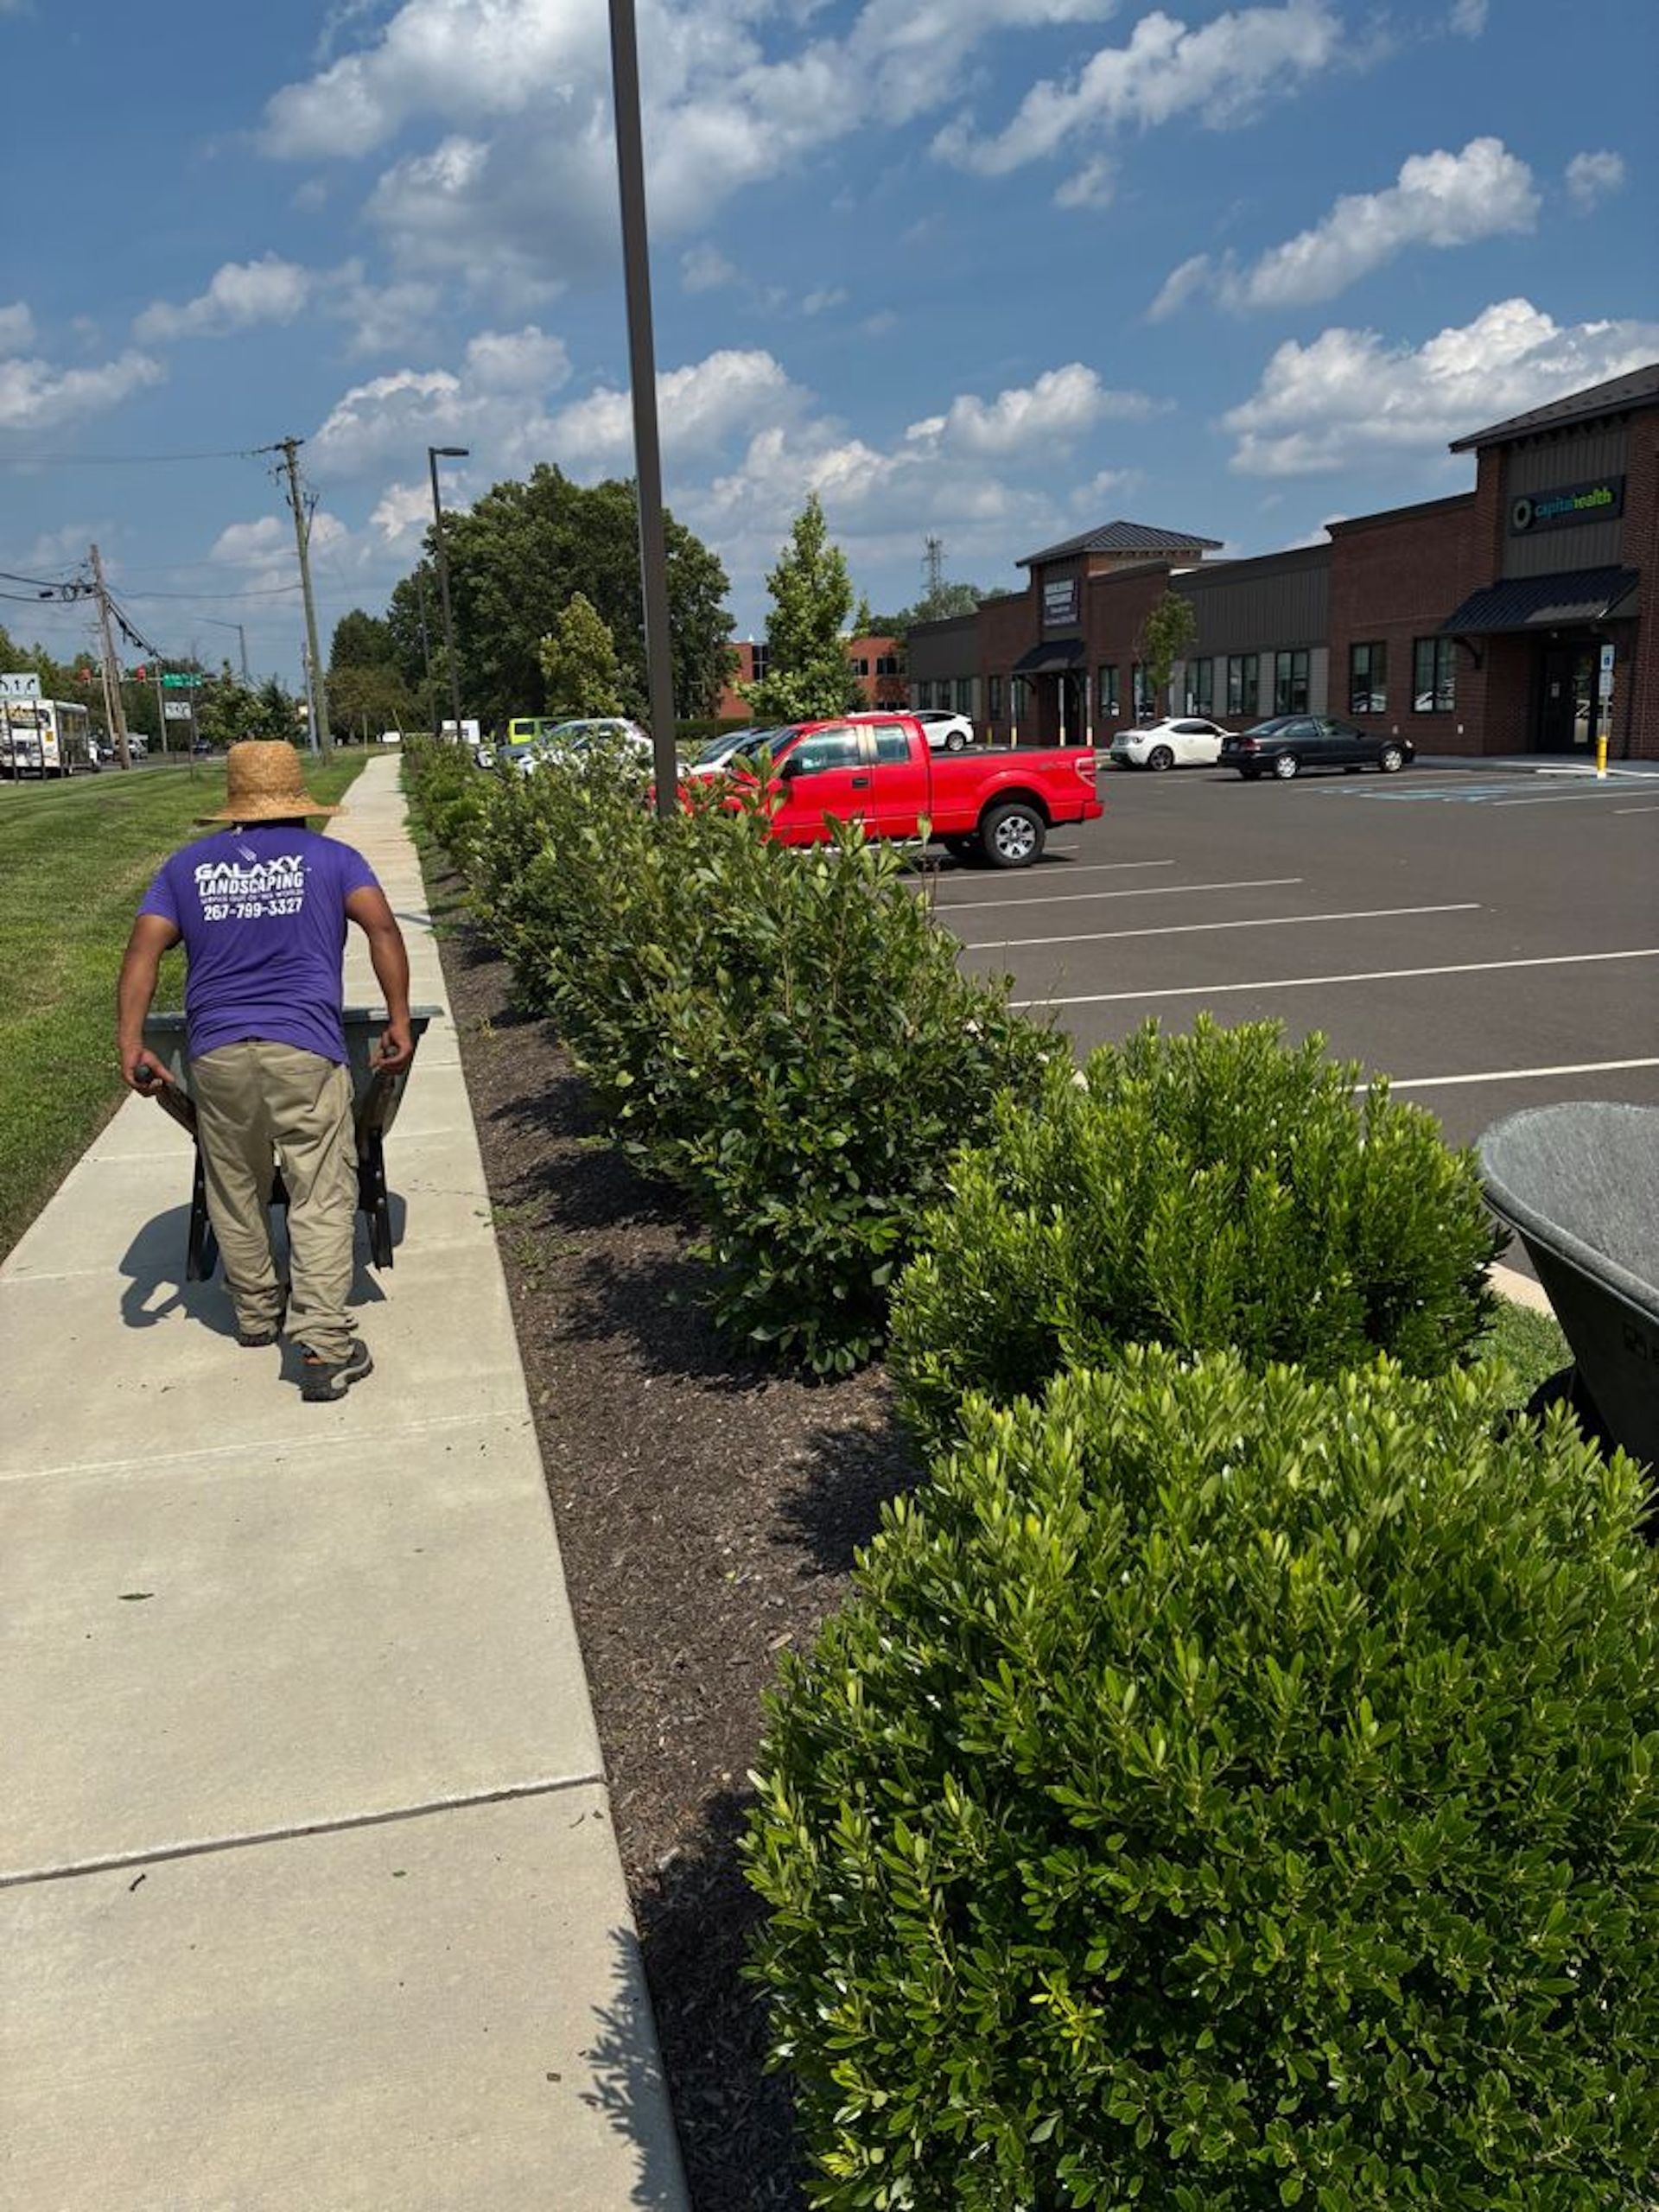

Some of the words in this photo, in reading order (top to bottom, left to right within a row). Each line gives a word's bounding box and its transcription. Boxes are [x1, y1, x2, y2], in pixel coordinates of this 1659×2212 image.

[195, 855, 303, 881] GALAXY
[200, 873, 304, 896] LANDSCAPING
[204, 898, 302, 921] 267-799-3327
